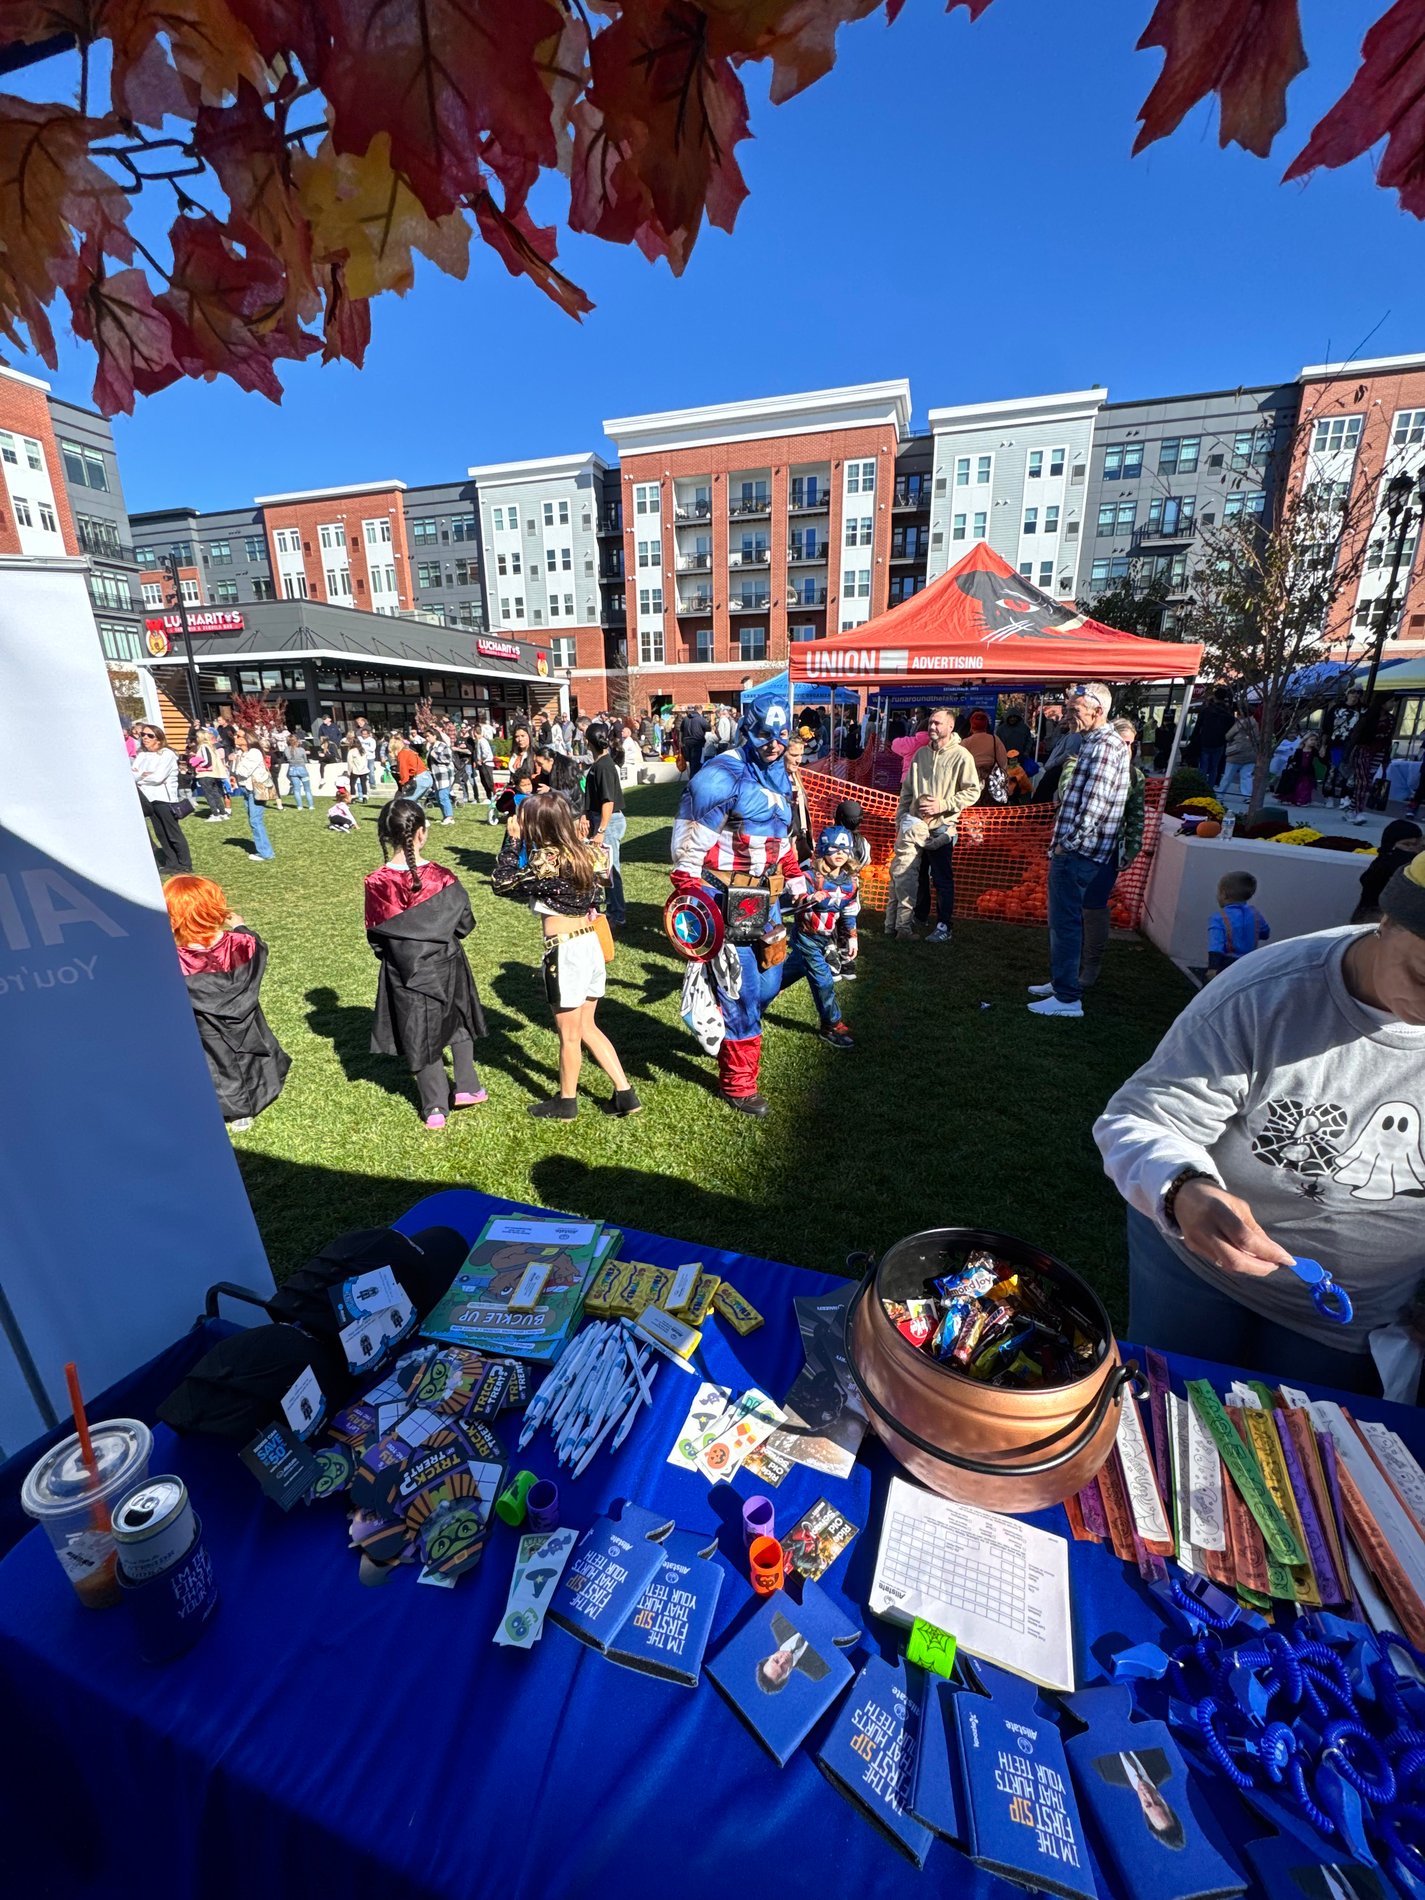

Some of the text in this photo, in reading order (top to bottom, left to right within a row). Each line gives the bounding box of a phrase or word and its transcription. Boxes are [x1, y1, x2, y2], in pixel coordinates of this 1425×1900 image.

[163, 611, 240, 628] LUHARITOS
[806, 650, 876, 678] UNION
[912, 656, 984, 670] ADVERTISING
[765, 706, 787, 726] A
[835, 833, 853, 846] A
[457, 1307, 545, 1327] BUCKLE UP
[473, 1376, 498, 1413] TRICK
[509, 1371, 519, 1402] TRIC
[346, 1414, 372, 1430] PLAY
[256, 1433, 284, 1460] SAVE
[466, 1425, 490, 1457] RICK
[415, 1454, 460, 1486] TRICK
[760, 1466, 779, 1482] Ride
[767, 1461, 785, 1475] Old
[811, 1510, 836, 1538] School
[828, 1517, 843, 1533] Old
[832, 1524, 852, 1544] Ride
[610, 1534, 634, 1551] Allstate
[572, 1559, 617, 1592] THAT HURTS
[586, 1550, 629, 1583] YOUR TEETH
[178, 1587, 207, 1619] YOUR
[566, 1575, 613, 1607] FIRST SIP
[672, 1589, 697, 1610] YOUR
[878, 1582, 905, 1599] Allstate
[570, 1594, 604, 1620] I'M THE
[636, 1595, 690, 1621] THAT HURT
[633, 1609, 689, 1640] FIRST SIP
[646, 1631, 686, 1656] I'M THE
[864, 1700, 896, 1737] TEETH
[1006, 1720, 1038, 1740] Allstate
[851, 1709, 915, 1777] THAT HURTS
[850, 1733, 912, 1799] FIRST SIP
[862, 1763, 888, 1796] THE
[998, 1751, 1066, 1795] YOUR TEETH
[995, 1770, 1067, 1815] THAT HURTS
[1009, 1797, 1075, 1844] FIRST SIP
[1035, 1829, 1081, 1868] I'M THE
